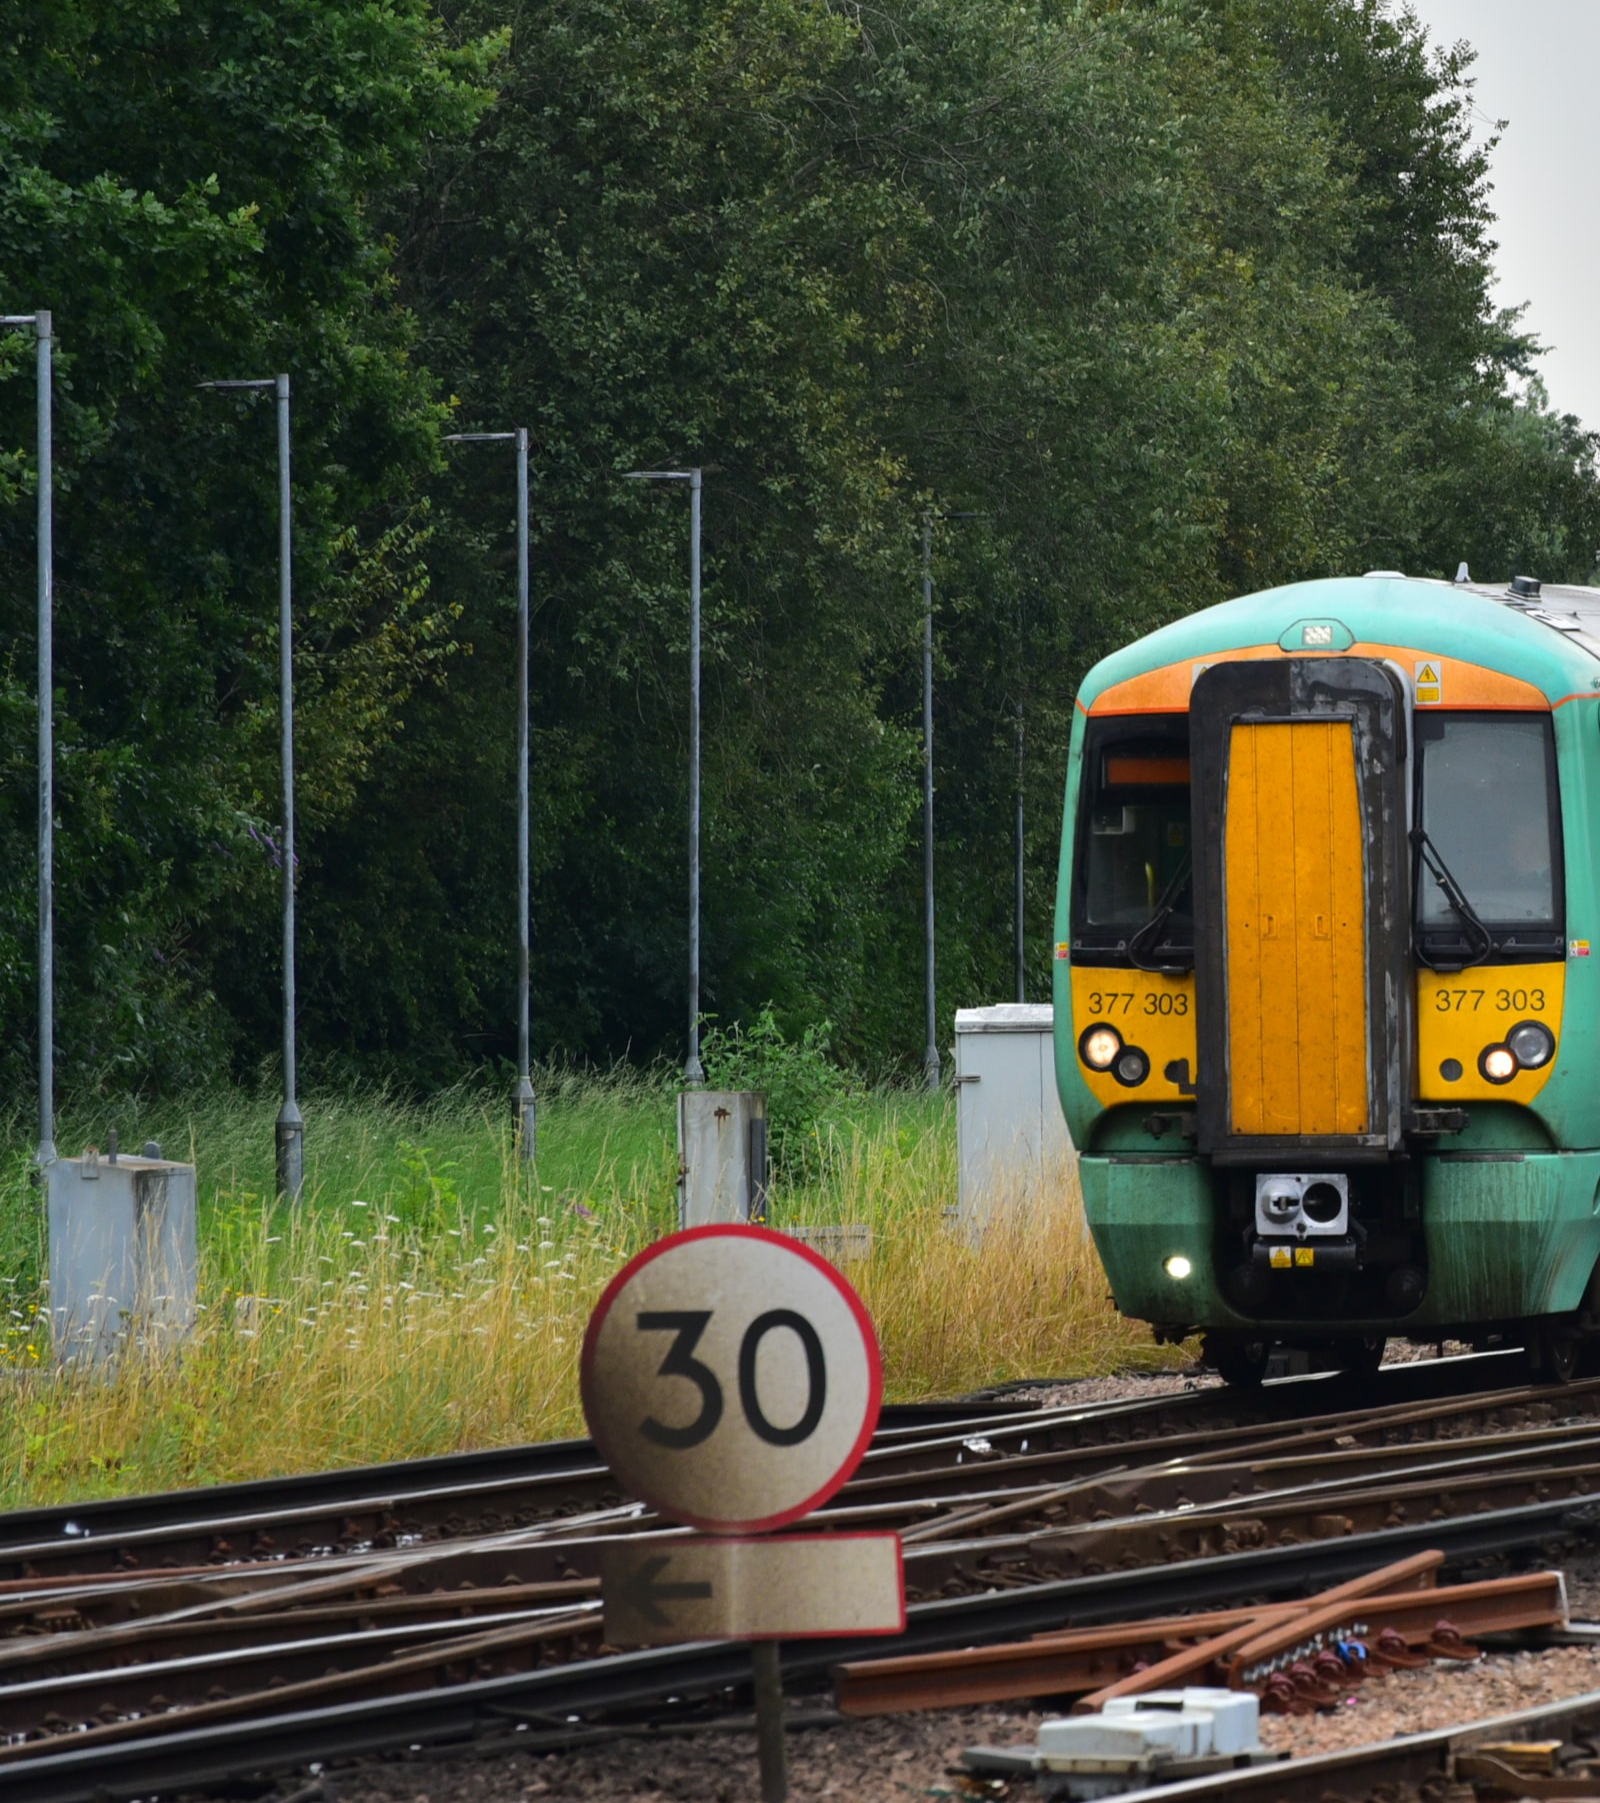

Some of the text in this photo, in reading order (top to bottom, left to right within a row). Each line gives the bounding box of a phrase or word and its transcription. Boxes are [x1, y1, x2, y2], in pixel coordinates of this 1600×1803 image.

[1088, 992, 1188, 1016] 377 303
[1435, 988, 1546, 1012] 377 303
[636, 1308, 827, 1448] 30
